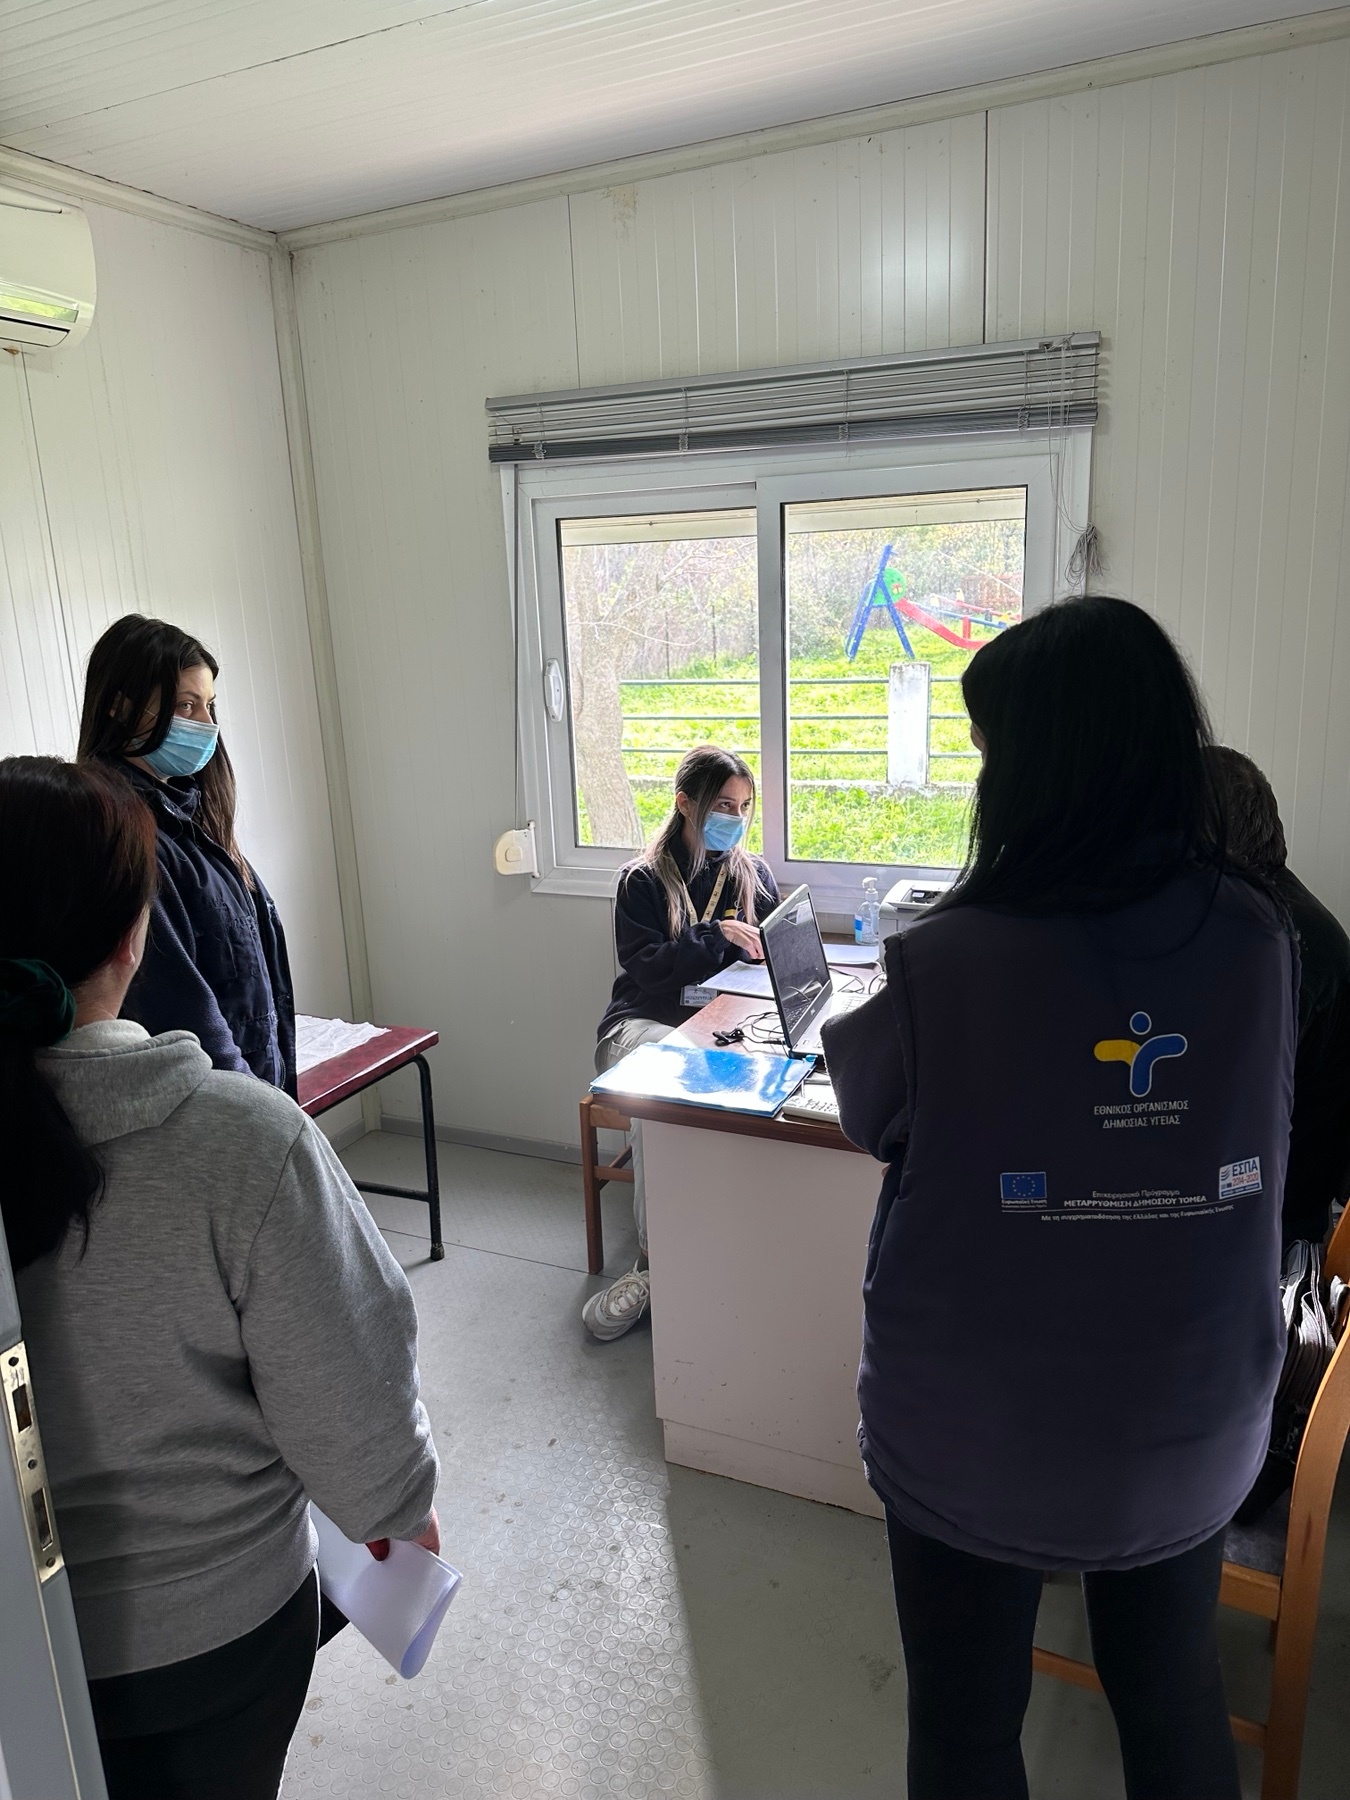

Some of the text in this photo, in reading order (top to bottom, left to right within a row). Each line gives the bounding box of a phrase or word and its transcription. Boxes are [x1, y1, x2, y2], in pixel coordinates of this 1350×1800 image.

[1094, 1100, 1189, 1115] ΕΘΝΙΚΟΣ ΟΡΓΑΝΙΣΜΟΣ
[1102, 1115, 1181, 1129] ΔΗΜΟΣΙΑΣ ΥΓΕΙΑΣ
[1232, 1159, 1258, 1176] ΕΣΠΑ
[1064, 1195, 1207, 1208] ΜΕΤΑΡΡΥΘΜΙΣΗ ΔΗΜΟΣΙΟΥ ΤΟΜΕΑ
